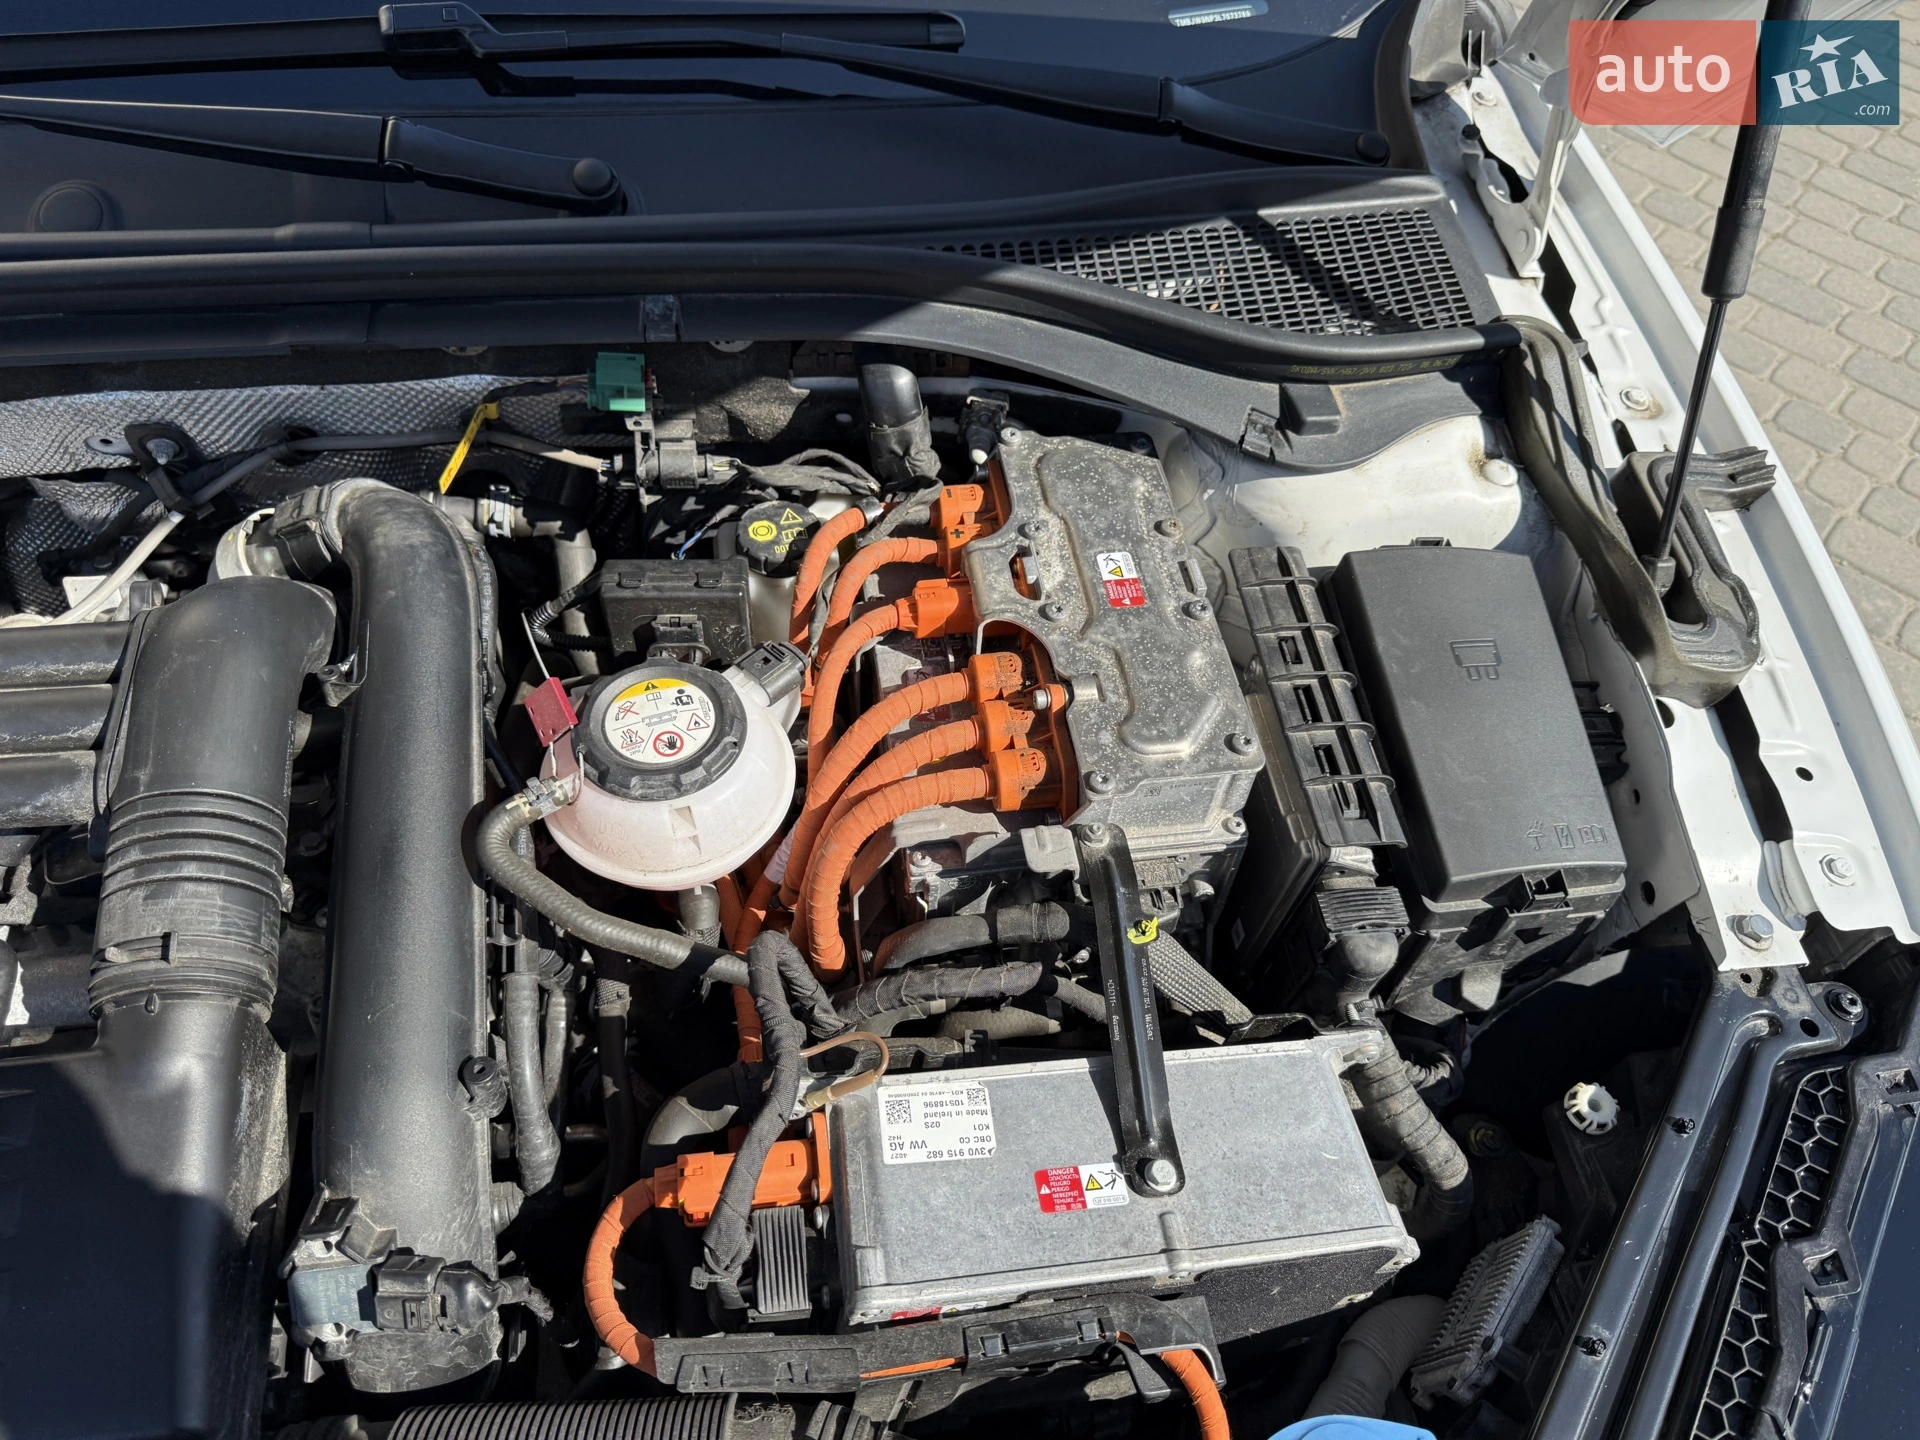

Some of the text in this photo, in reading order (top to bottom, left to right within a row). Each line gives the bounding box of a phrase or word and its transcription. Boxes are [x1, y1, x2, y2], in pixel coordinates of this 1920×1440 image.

[774, 544, 789, 554] DOT
[923, 1099, 964, 1109] 10518896
[923, 1110, 953, 1119] Ireland
[955, 1109, 963, 1117] in
[973, 1135, 992, 1143] OBC
[889, 1140, 928, 1151] VW AG
[926, 1147, 986, 1159] 3V0 915 682
[1047, 1167, 1075, 1176] DANGER
